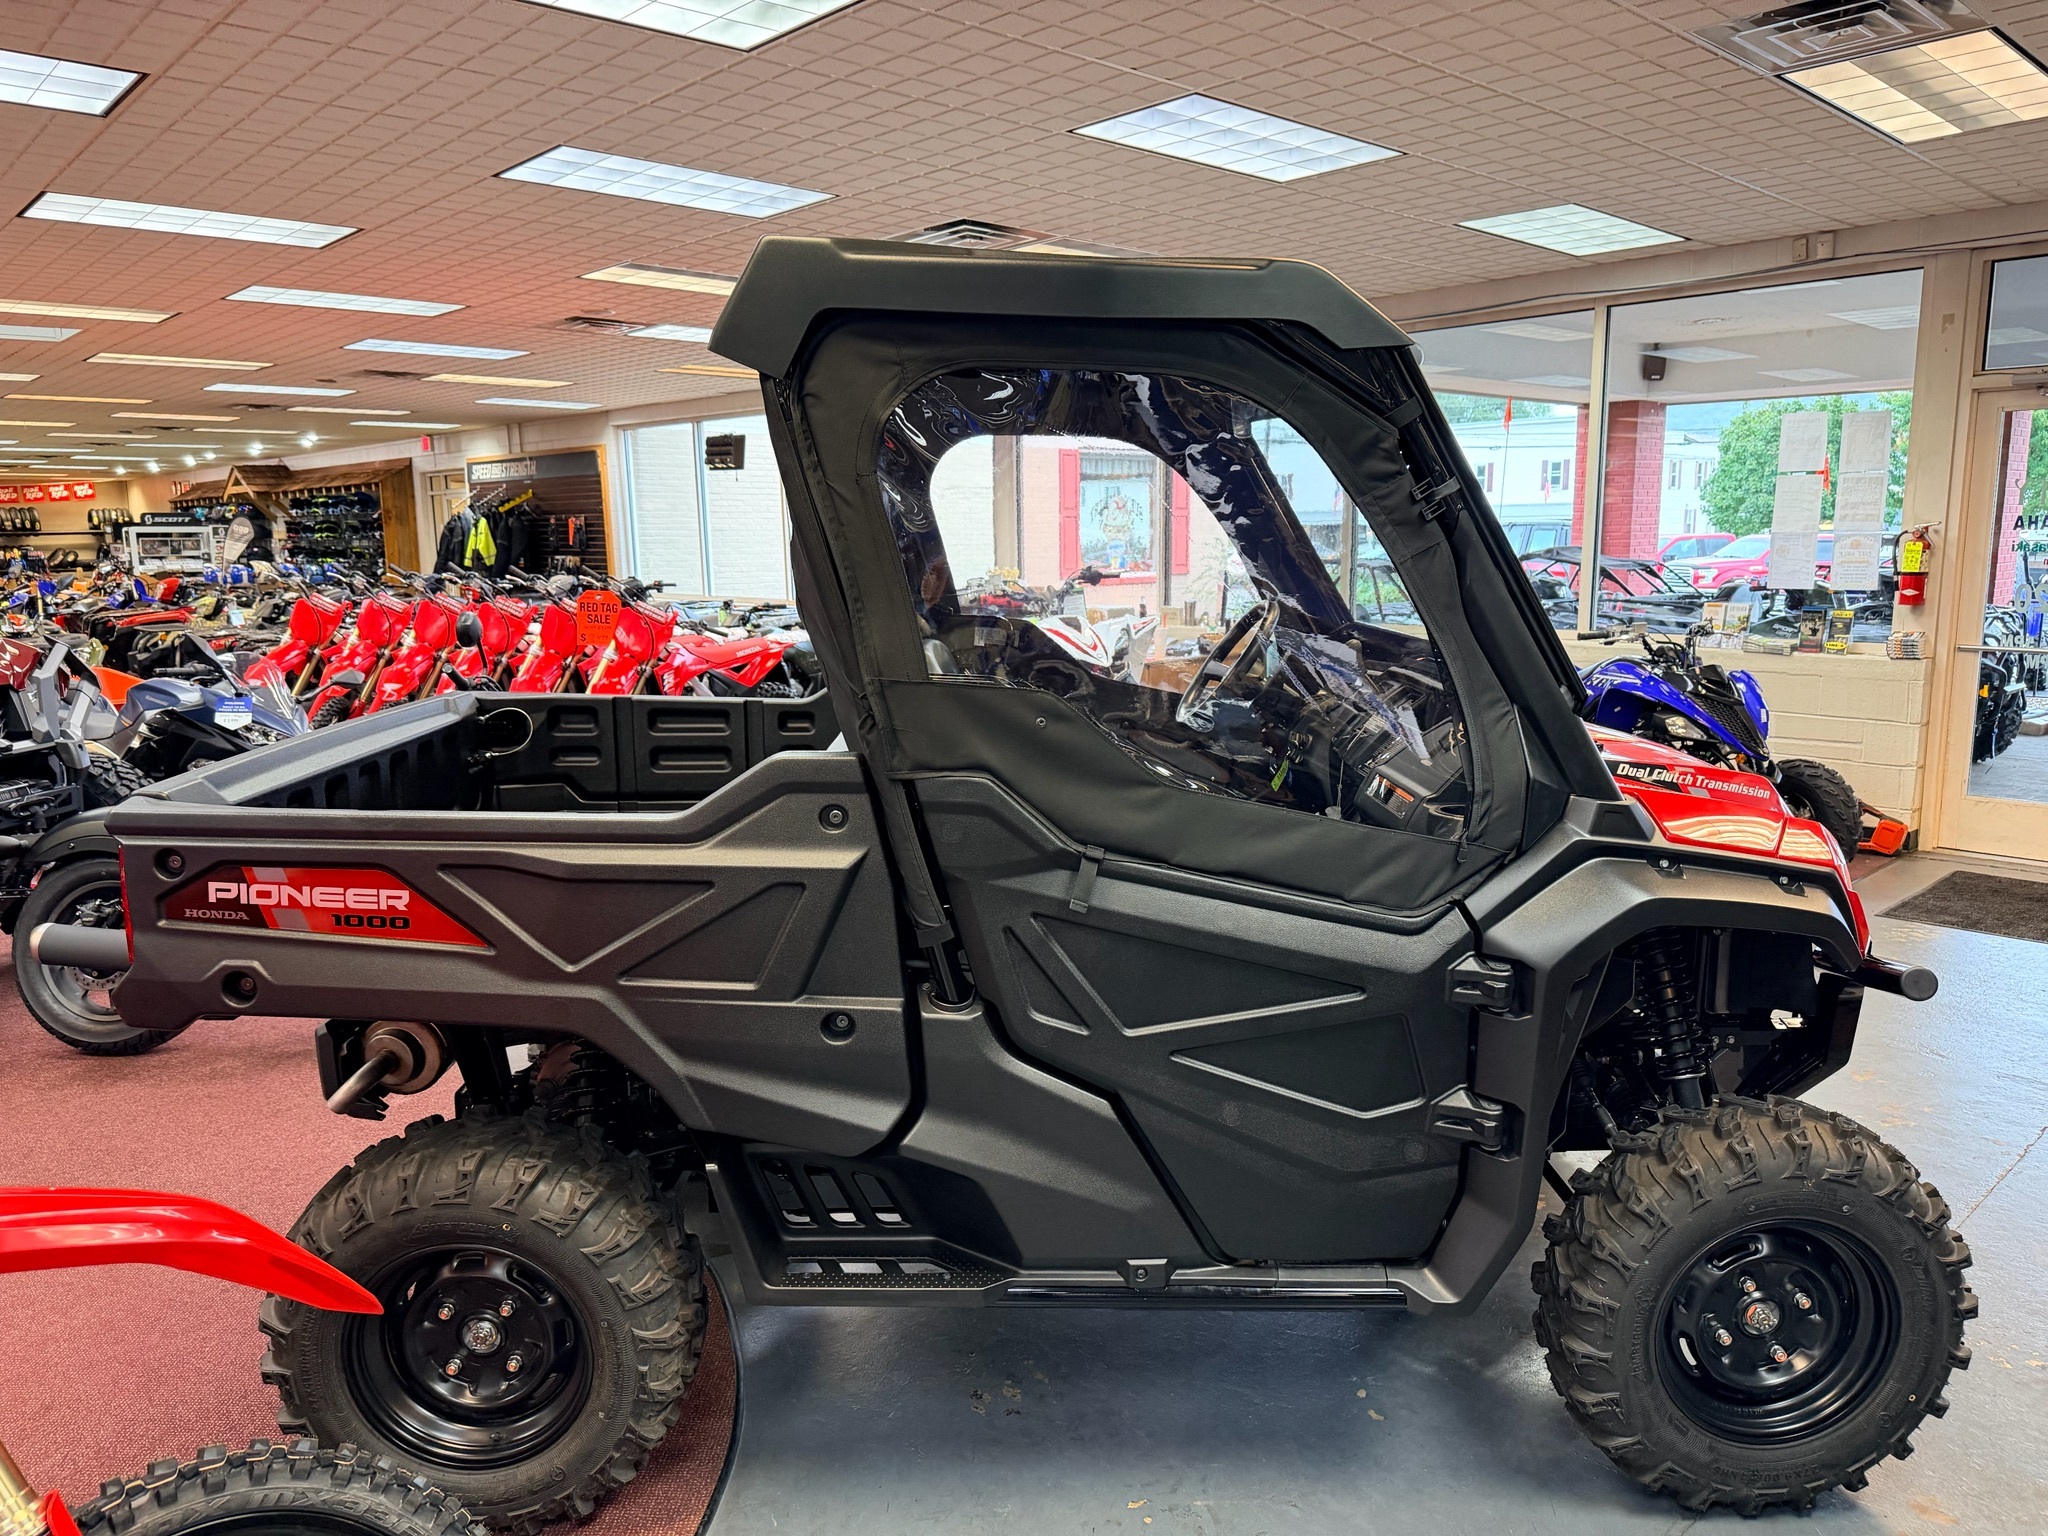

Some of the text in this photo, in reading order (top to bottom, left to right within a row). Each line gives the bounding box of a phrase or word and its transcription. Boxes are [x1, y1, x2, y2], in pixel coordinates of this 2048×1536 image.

[471, 463, 491, 480] SPEED
[579, 602, 618, 613] RED TAG
[587, 613, 611, 625] SALE
[735, 645, 762, 657] HONDA
[1616, 763, 1771, 799] Dual Clutch Transmission
[207, 881, 410, 911] PIONEER
[183, 908, 250, 921] HONDA
[330, 913, 411, 930] 1000
